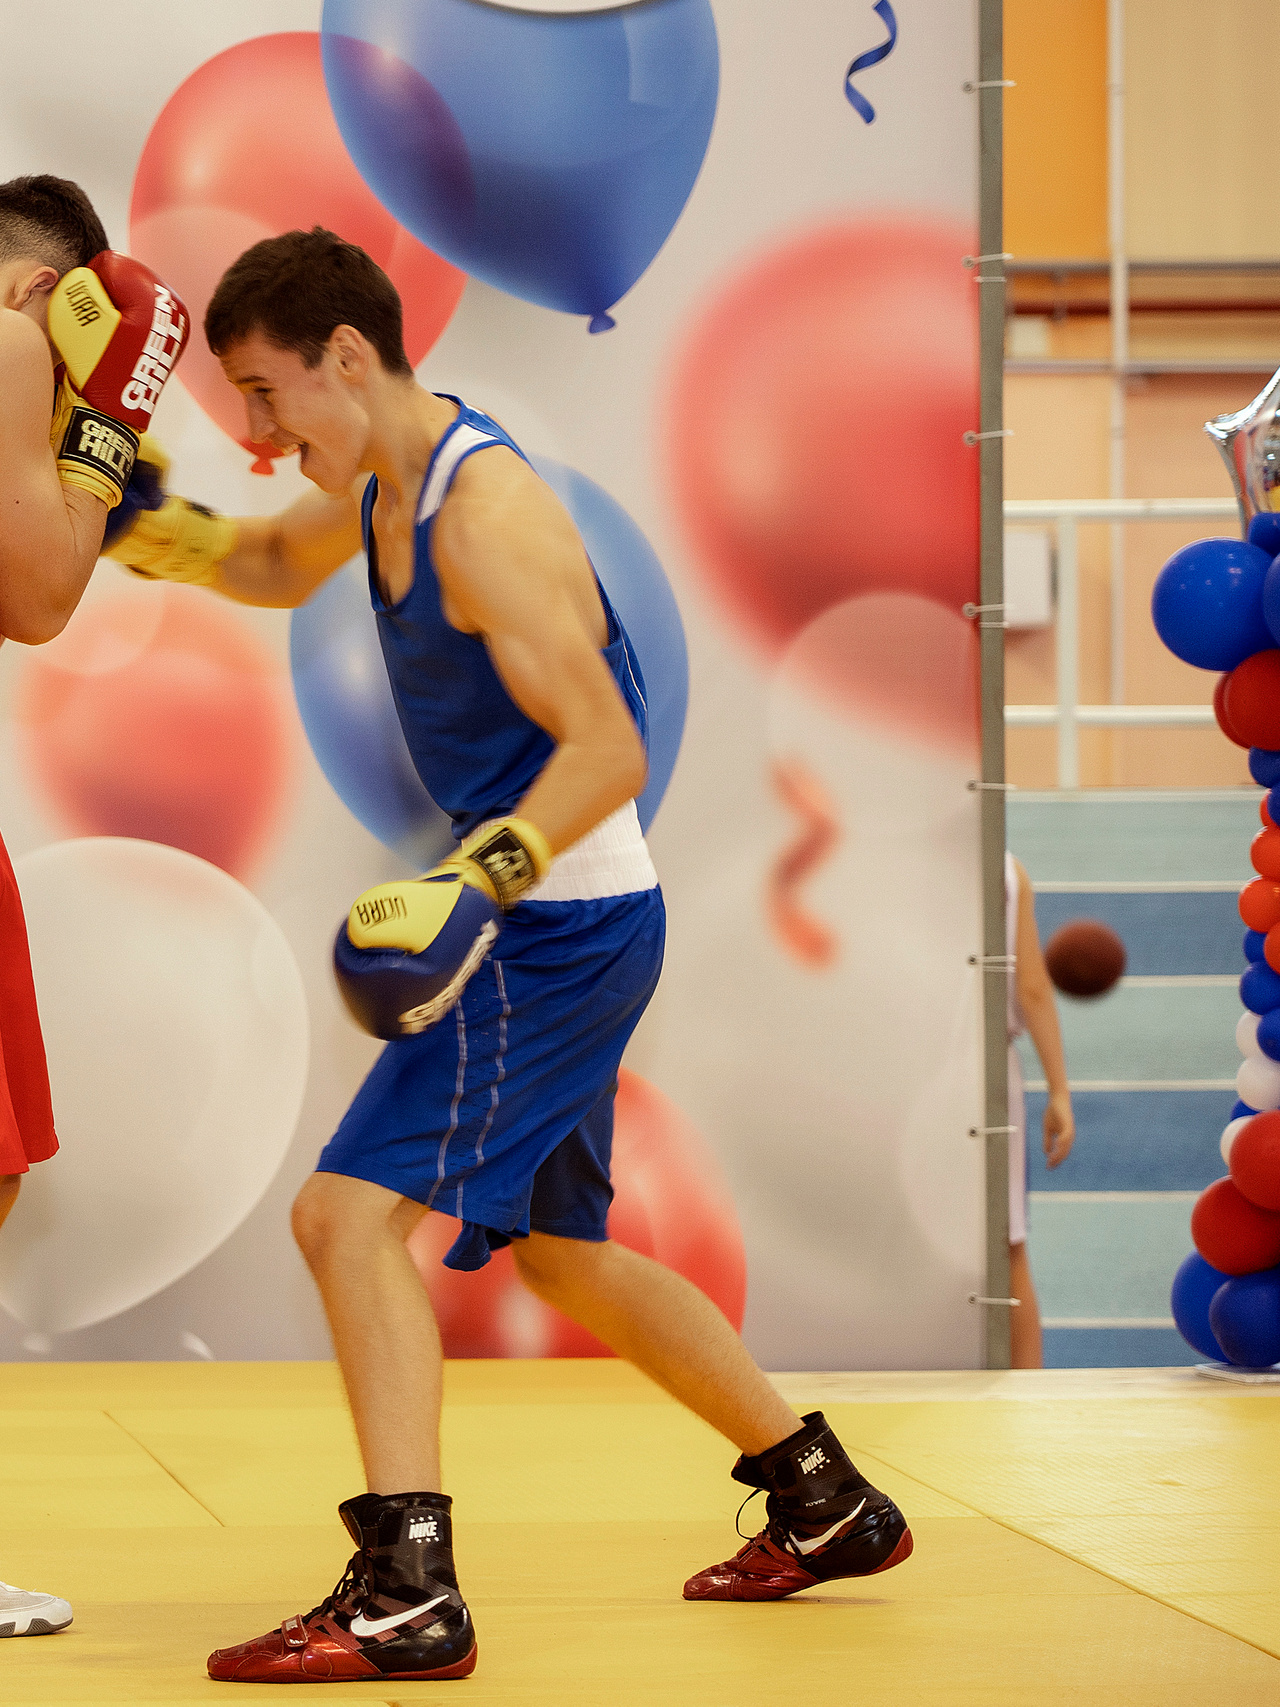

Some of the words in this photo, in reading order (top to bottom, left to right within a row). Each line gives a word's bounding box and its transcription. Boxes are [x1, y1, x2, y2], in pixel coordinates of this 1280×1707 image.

[120, 283, 172, 410] GREEN
[78, 433, 125, 479] HILL
[800, 1447, 826, 1475] NIKE
[409, 1521, 438, 1539] NIKE
